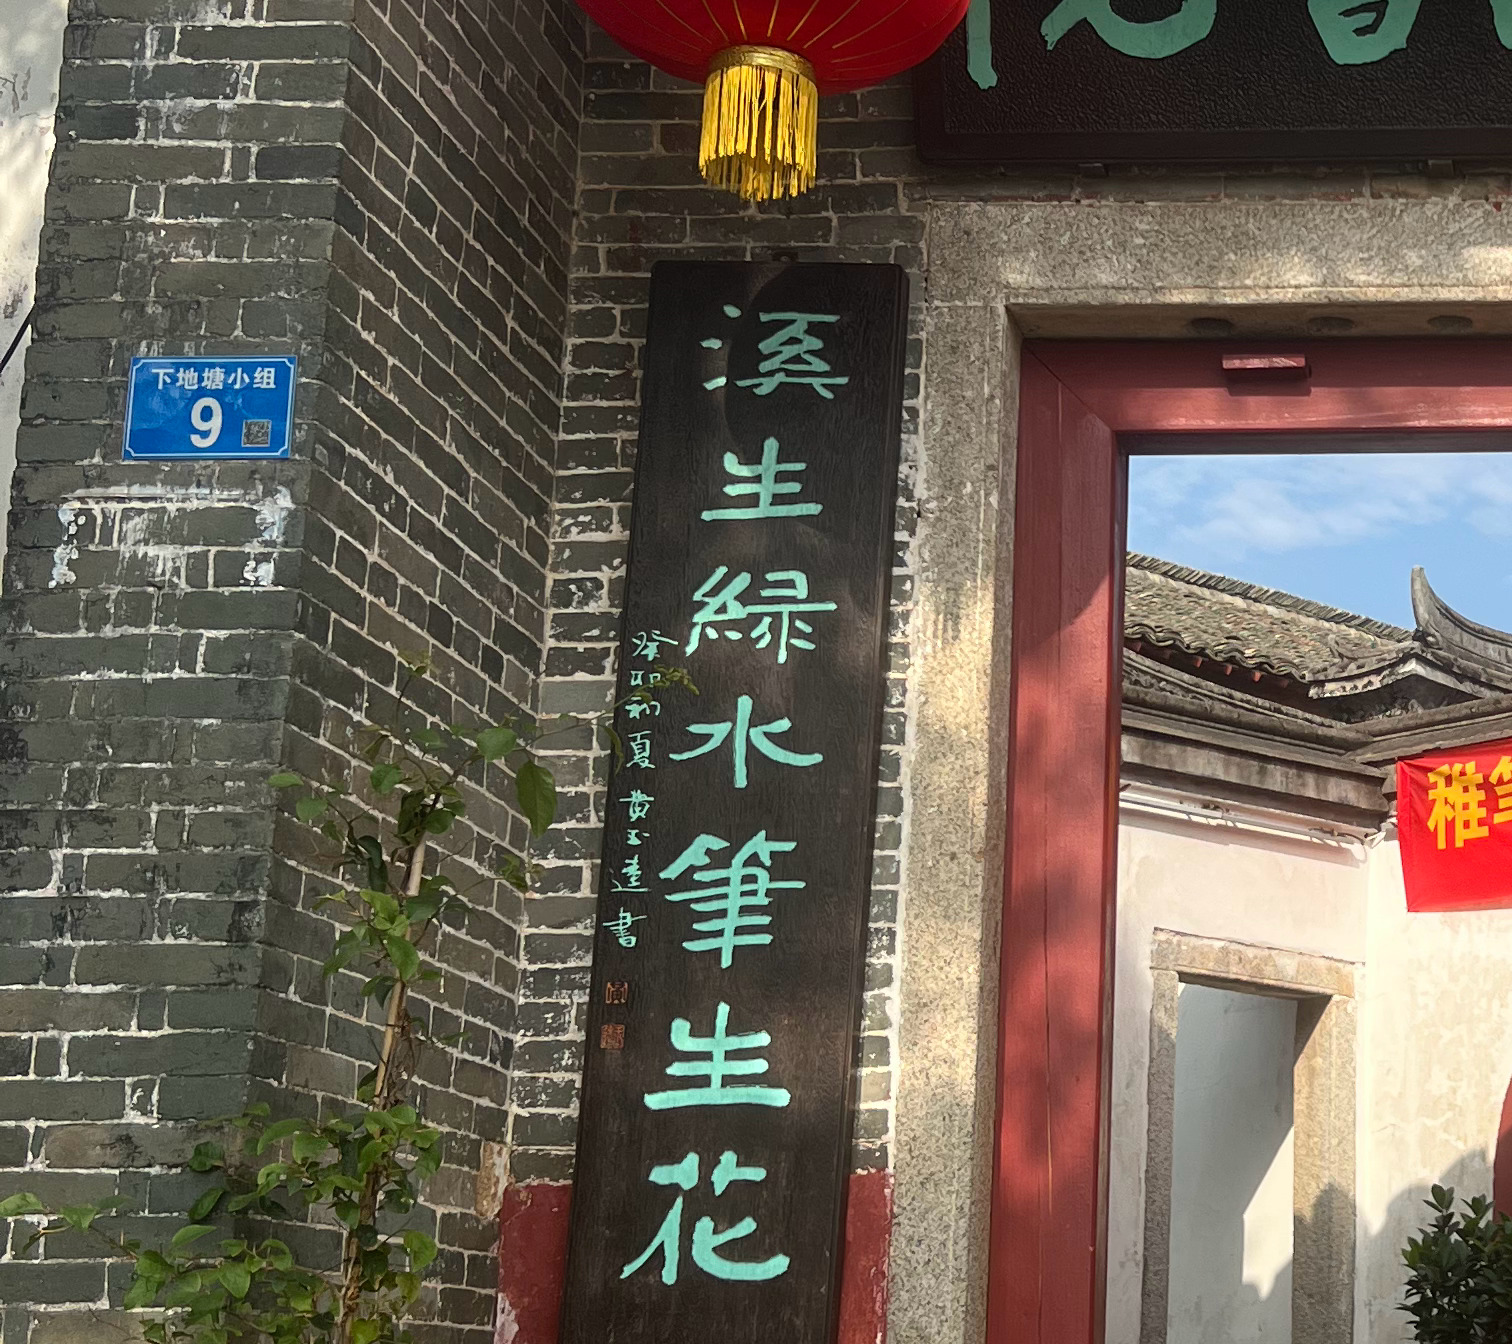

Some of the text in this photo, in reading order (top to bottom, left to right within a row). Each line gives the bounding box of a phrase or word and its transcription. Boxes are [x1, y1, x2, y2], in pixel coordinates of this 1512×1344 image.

[151, 367, 276, 390] 下地塘小组
[189, 397, 223, 449] 9
